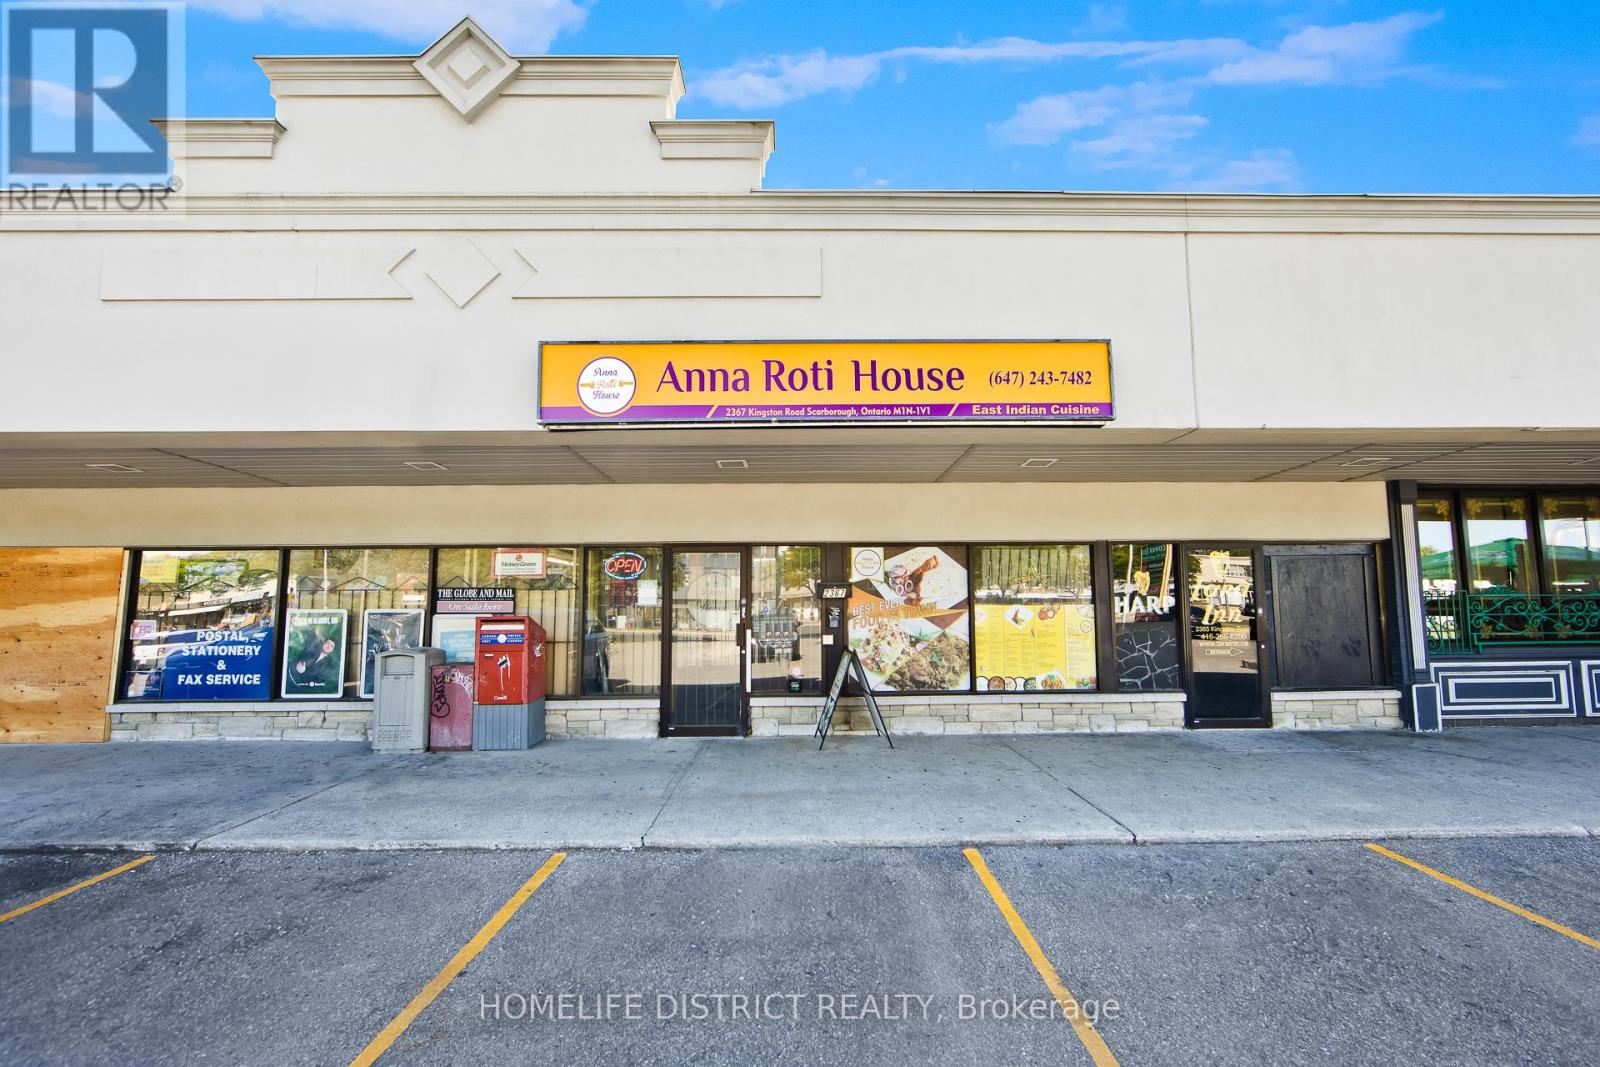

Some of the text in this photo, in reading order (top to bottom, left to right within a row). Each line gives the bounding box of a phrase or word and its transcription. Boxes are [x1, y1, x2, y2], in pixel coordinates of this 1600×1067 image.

[593, 367, 618, 377] Anna
[656, 359, 1092, 393] Anna Roti House (647) 243-7482
[592, 390, 620, 400] House
[725, 406, 931, 418] 2367 Kingston Road Scarborough, Ontario M1N-1V1
[972, 404, 1100, 415] East Indian Cuisine
[607, 559, 643, 573] OPEN
[438, 588, 515, 598] THE GLOBE AND MAIL
[823, 588, 847, 598] 2367
[464, 602, 481, 611] Sale
[853, 603, 875, 616] BEST
[1114, 595, 1176, 614] HARP
[196, 630, 250, 643] POSTAL,
[182, 645, 262, 656] STATIONERY
[216, 660, 227, 671] &
[178, 674, 261, 685] FAX SERVICE
